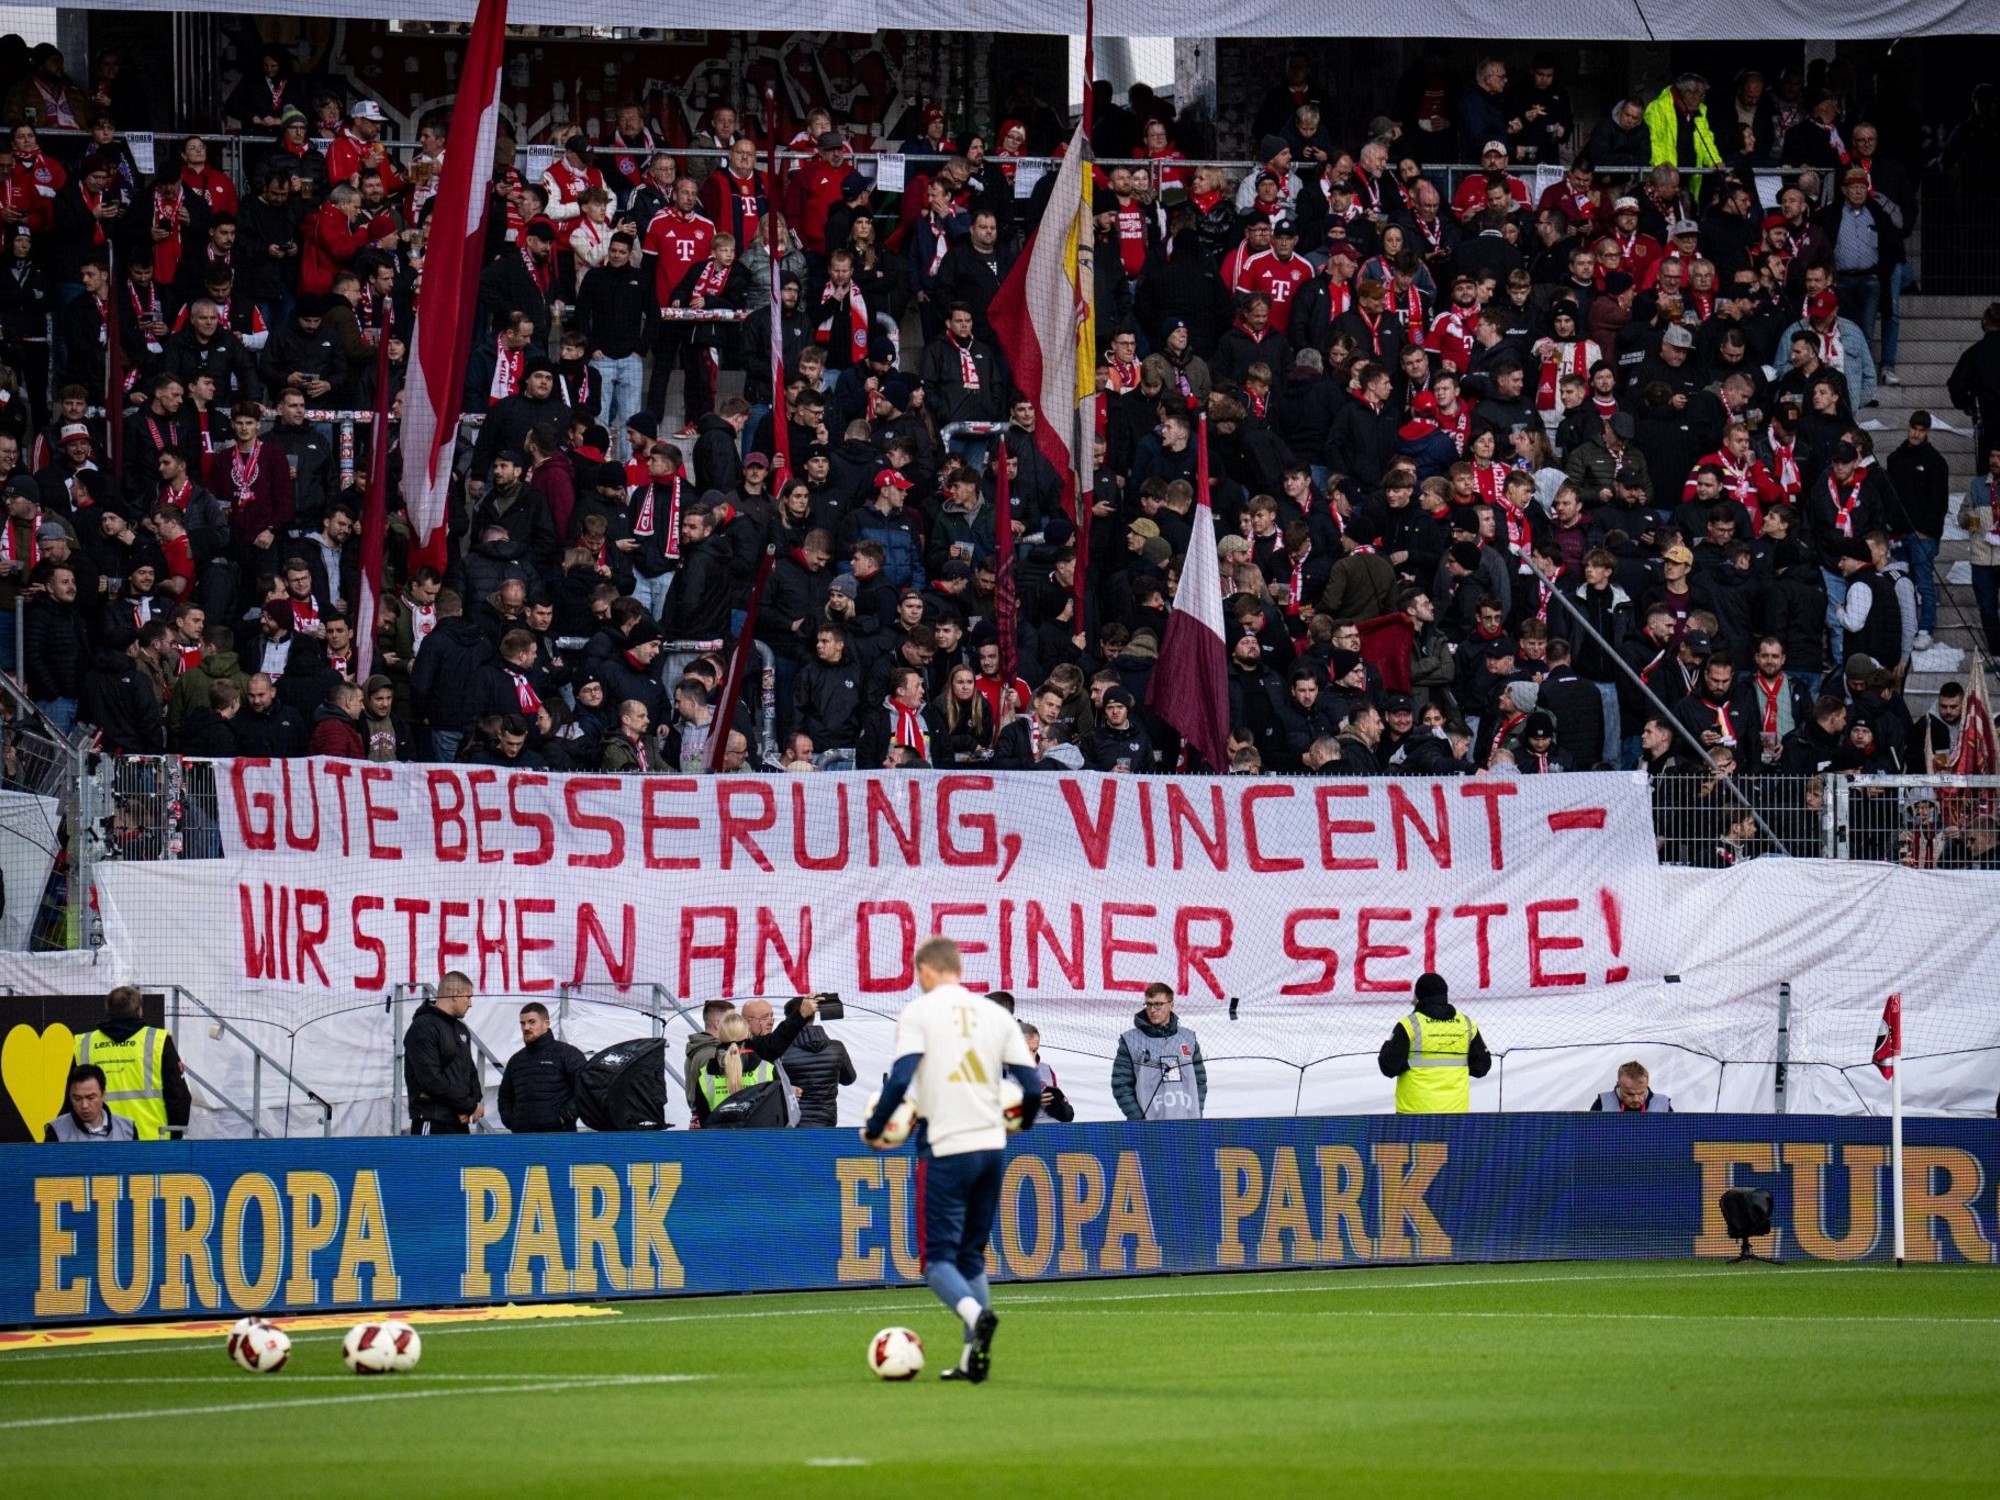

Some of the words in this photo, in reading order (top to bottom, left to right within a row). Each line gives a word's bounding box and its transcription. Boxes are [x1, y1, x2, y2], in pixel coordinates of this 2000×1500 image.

[676, 239, 695, 262] T
[1272, 280, 1291, 302] T
[231, 757, 403, 860] GUTE
[428, 768, 1023, 882] BESSERUNG,
[1060, 778, 1518, 874] VINCENT
[239, 882, 331, 988] WIR
[350, 893, 637, 993] STEHEN
[677, 904, 813, 999] AN
[856, 898, 1235, 1000] DEINER
[1279, 887, 1630, 996] SEITE!
[34, 1169, 402, 1316] EUROPA
[461, 1161, 685, 1298] PARK
[836, 1151, 1163, 1281] EUOPA
[1215, 1141, 1454, 1265] PARK
[1693, 1142, 2000, 1263] EUR
